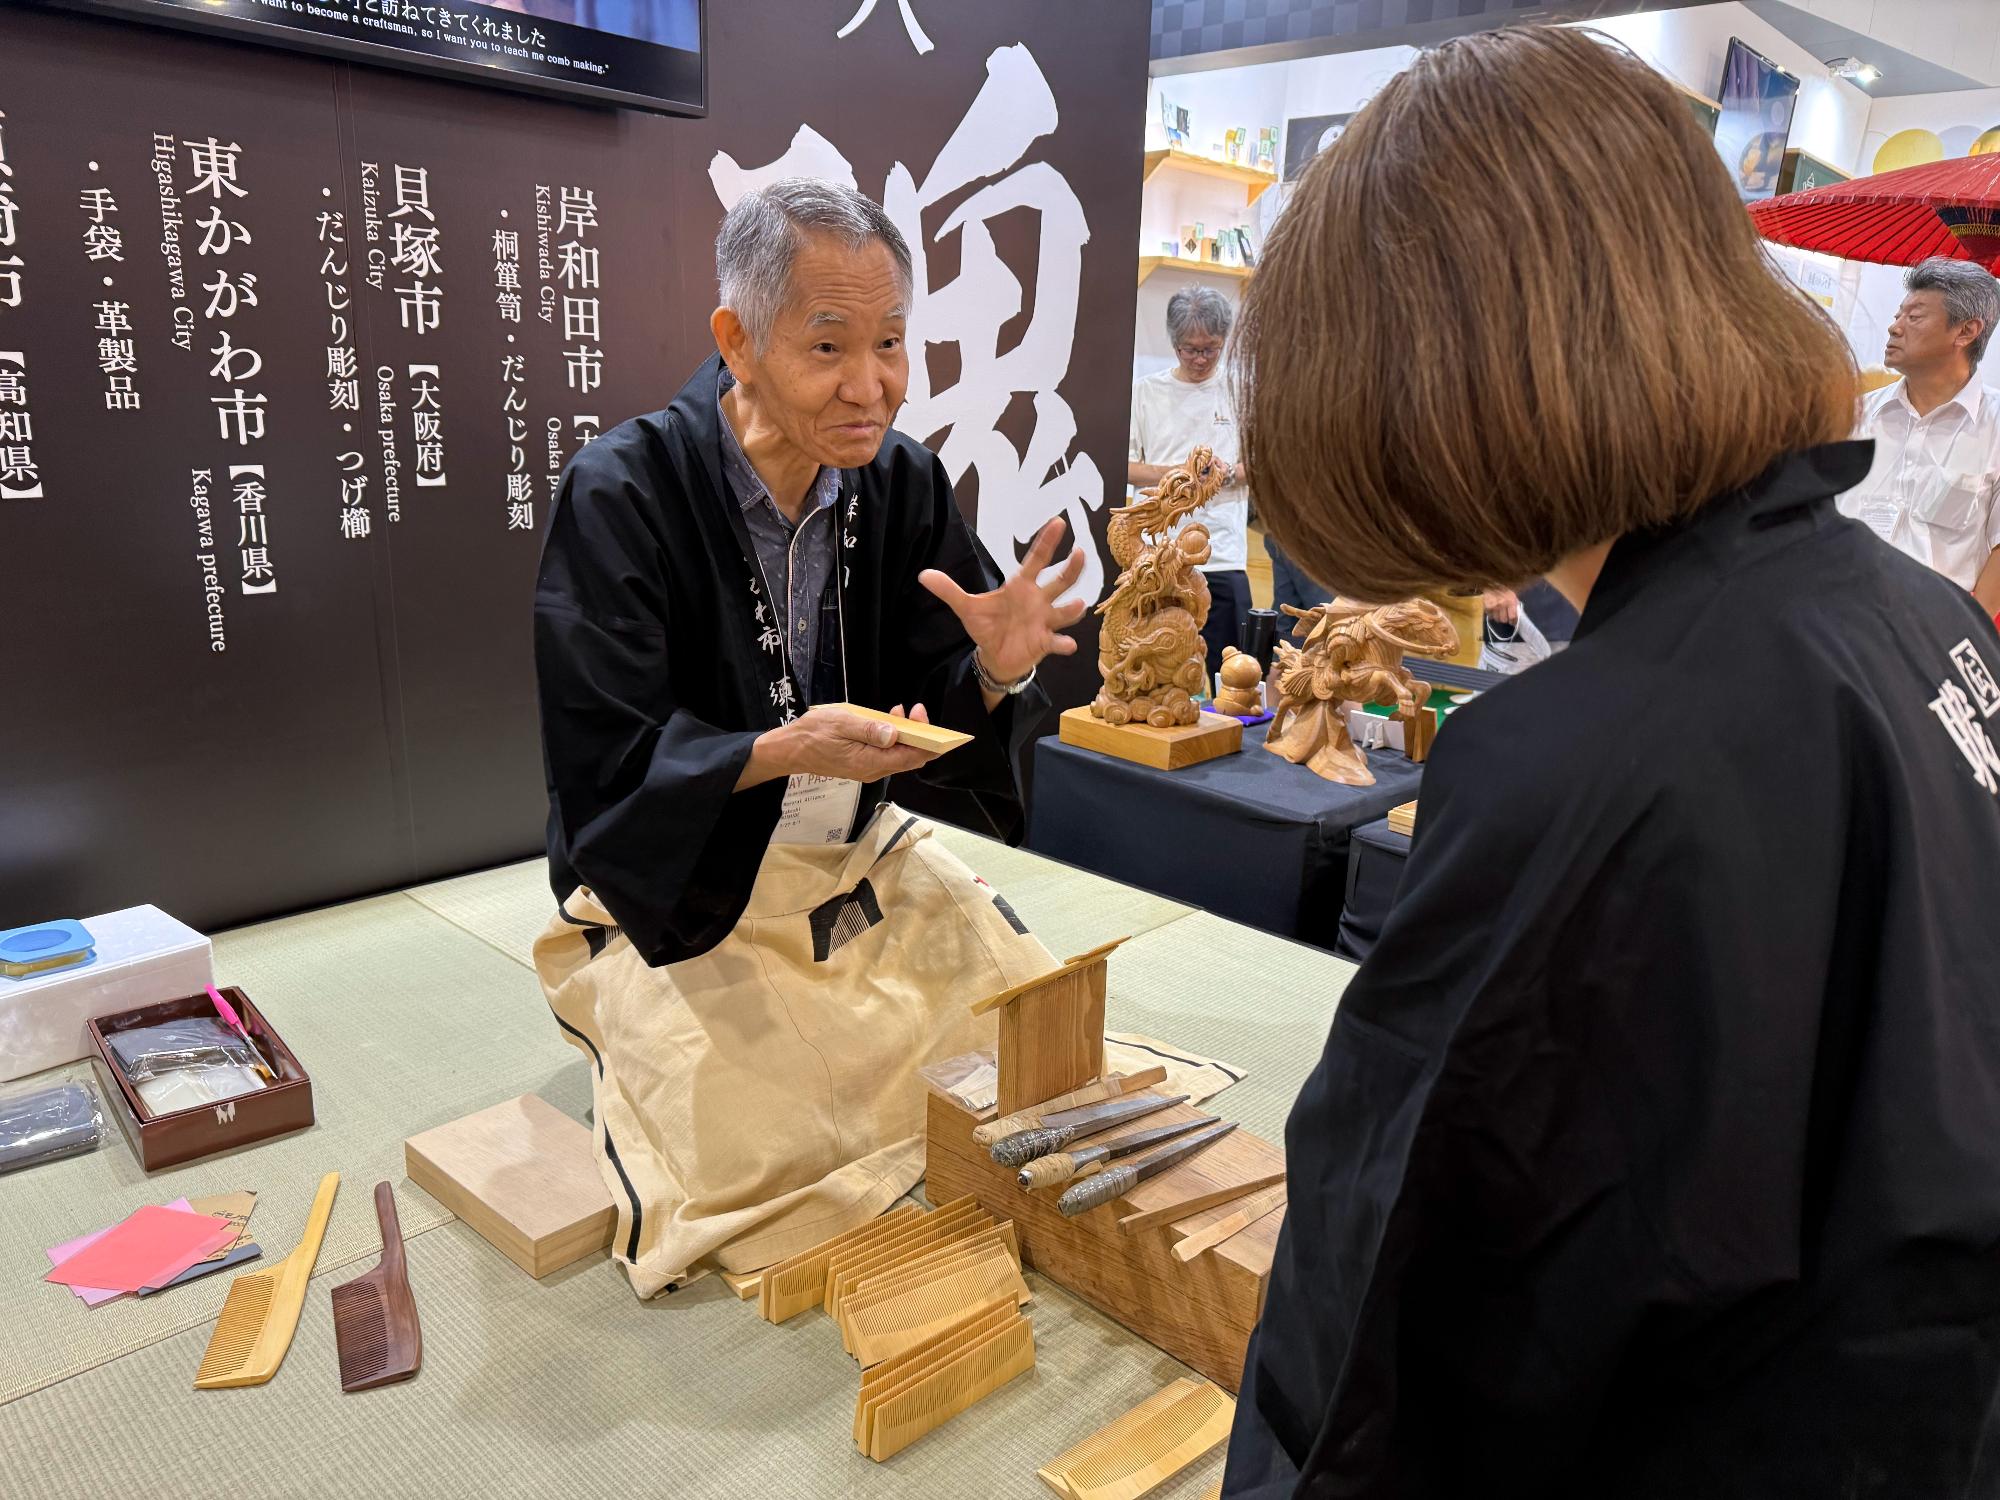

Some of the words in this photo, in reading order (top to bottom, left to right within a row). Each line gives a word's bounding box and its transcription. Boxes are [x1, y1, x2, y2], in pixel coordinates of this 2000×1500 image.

[291, 1, 303, 12] to
[307, 3, 349, 21] become
[352, 14, 360, 24] a
[362, 17, 417, 36] craftsman,
[421, 29, 433, 38] so
[443, 33, 467, 46] want
[470, 38, 487, 49] you
[491, 42, 500, 52] to
[503, 45, 528, 58] teach
[531, 51, 544, 61] me
[547, 55, 570, 66] comb
[151, 131, 187, 300] Higashikagawa
[361, 161, 380, 242] Kaizuka
[535, 184, 555, 280] Kishiwada
[366, 248, 386, 291] City
[387, 163, 443, 335] 貝塚市
[556, 186, 604, 394] 岸和田市
[171, 307, 194, 351] City
[538, 286, 555, 323] City
[182, 136, 268, 446] 東かがわ市
[228, 464, 277, 595] 【香川県】
[376, 365, 397, 424] Osaka
[408, 364, 447, 487] 【大阪府】
[546, 417, 564, 470] Osaka
[190, 468, 214, 548] Kagawa
[377, 429, 400, 522] prefecture
[197, 553, 226, 652] prefecture
